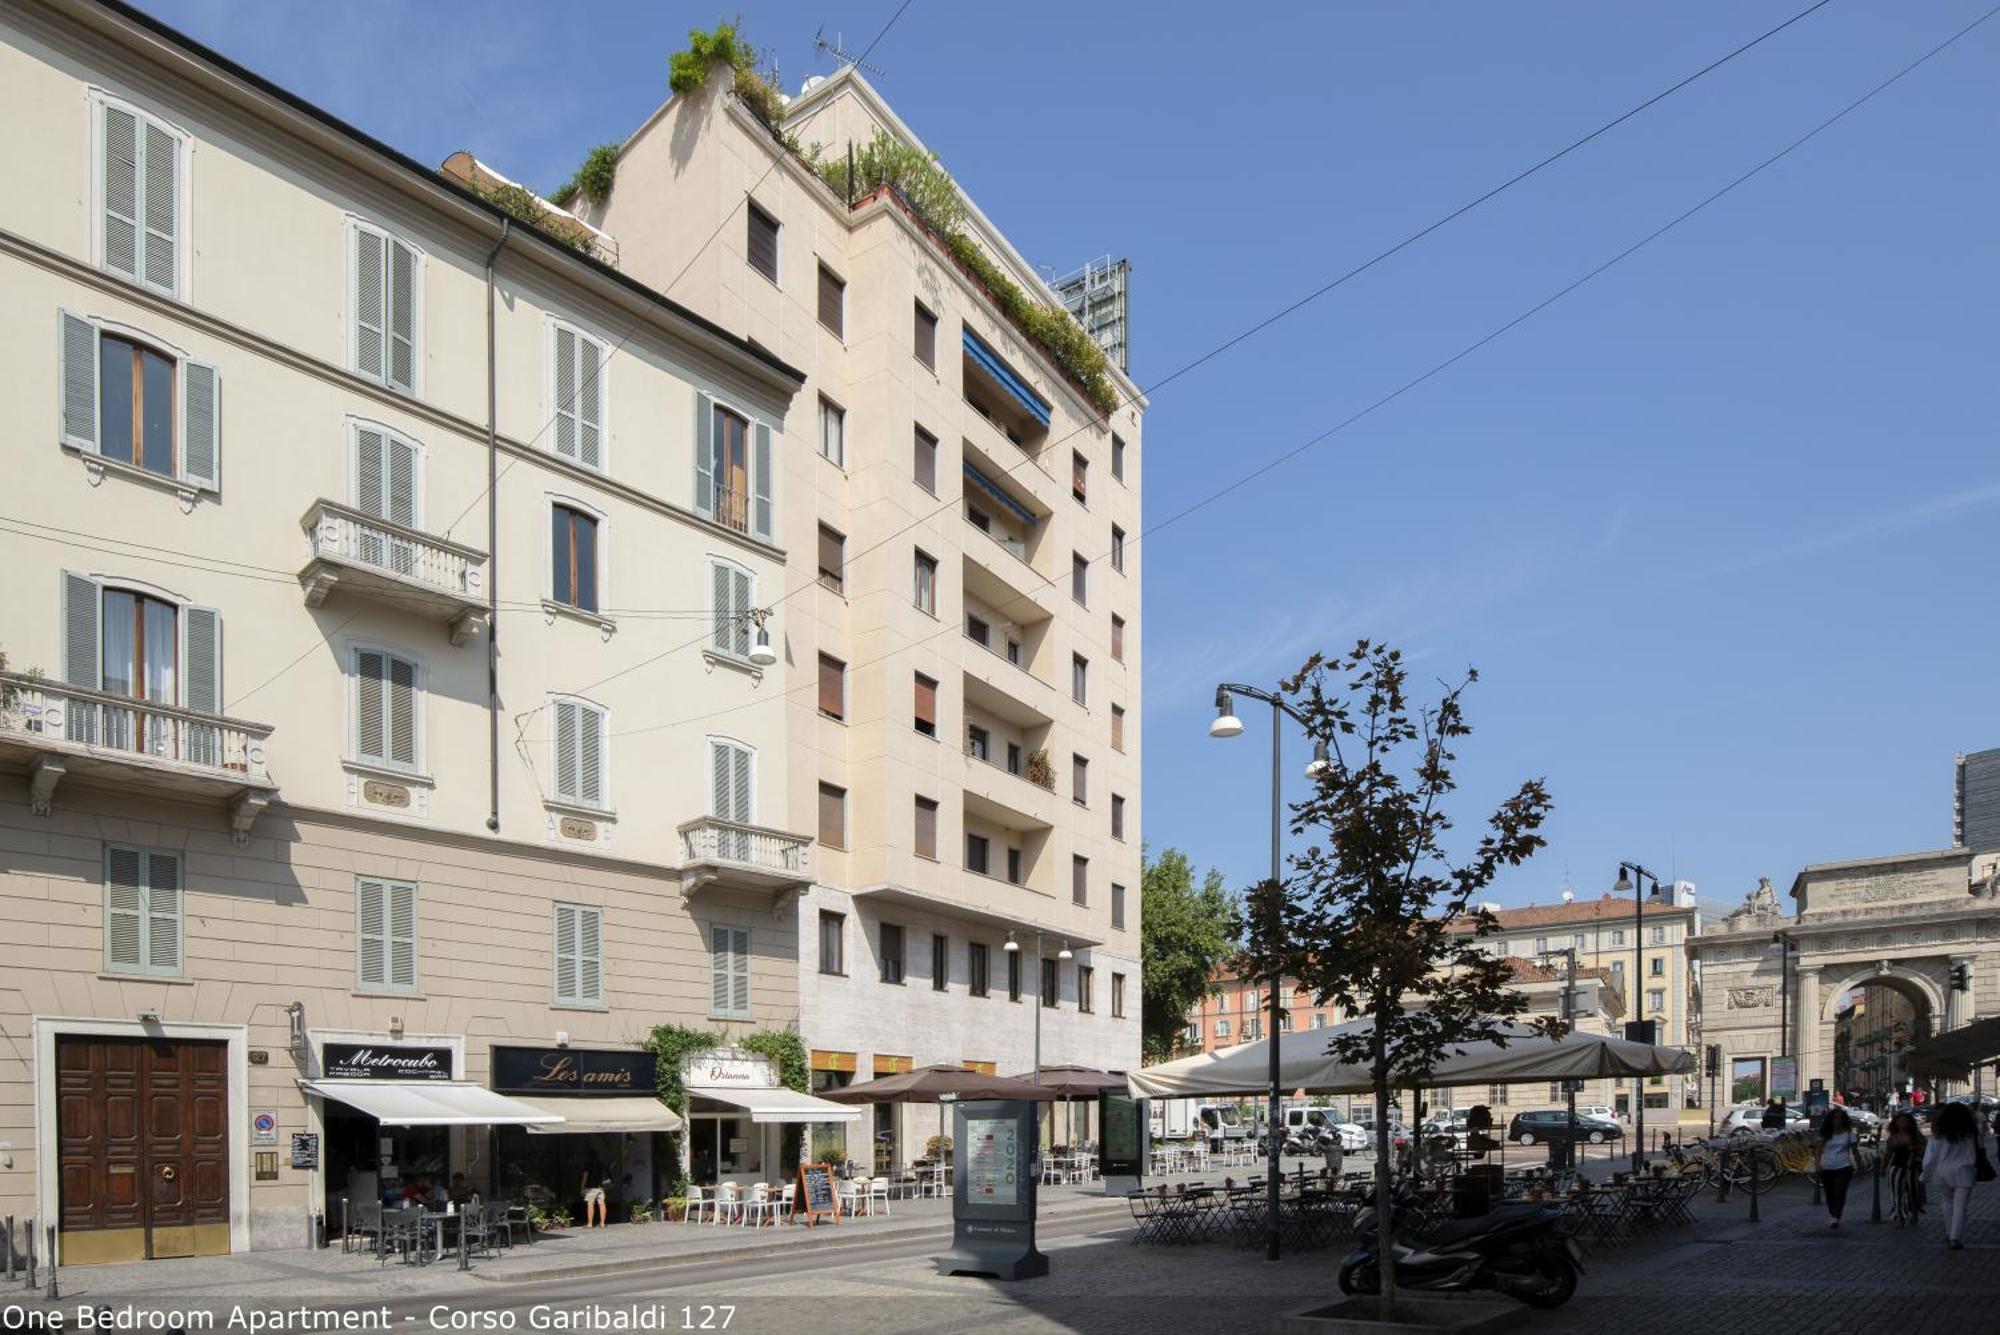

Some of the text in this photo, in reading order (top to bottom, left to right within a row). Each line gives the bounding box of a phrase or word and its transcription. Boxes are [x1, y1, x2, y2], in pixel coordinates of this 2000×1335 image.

[339, 1049, 438, 1068] Metrocubo
[533, 1053, 632, 1083] Les amis
